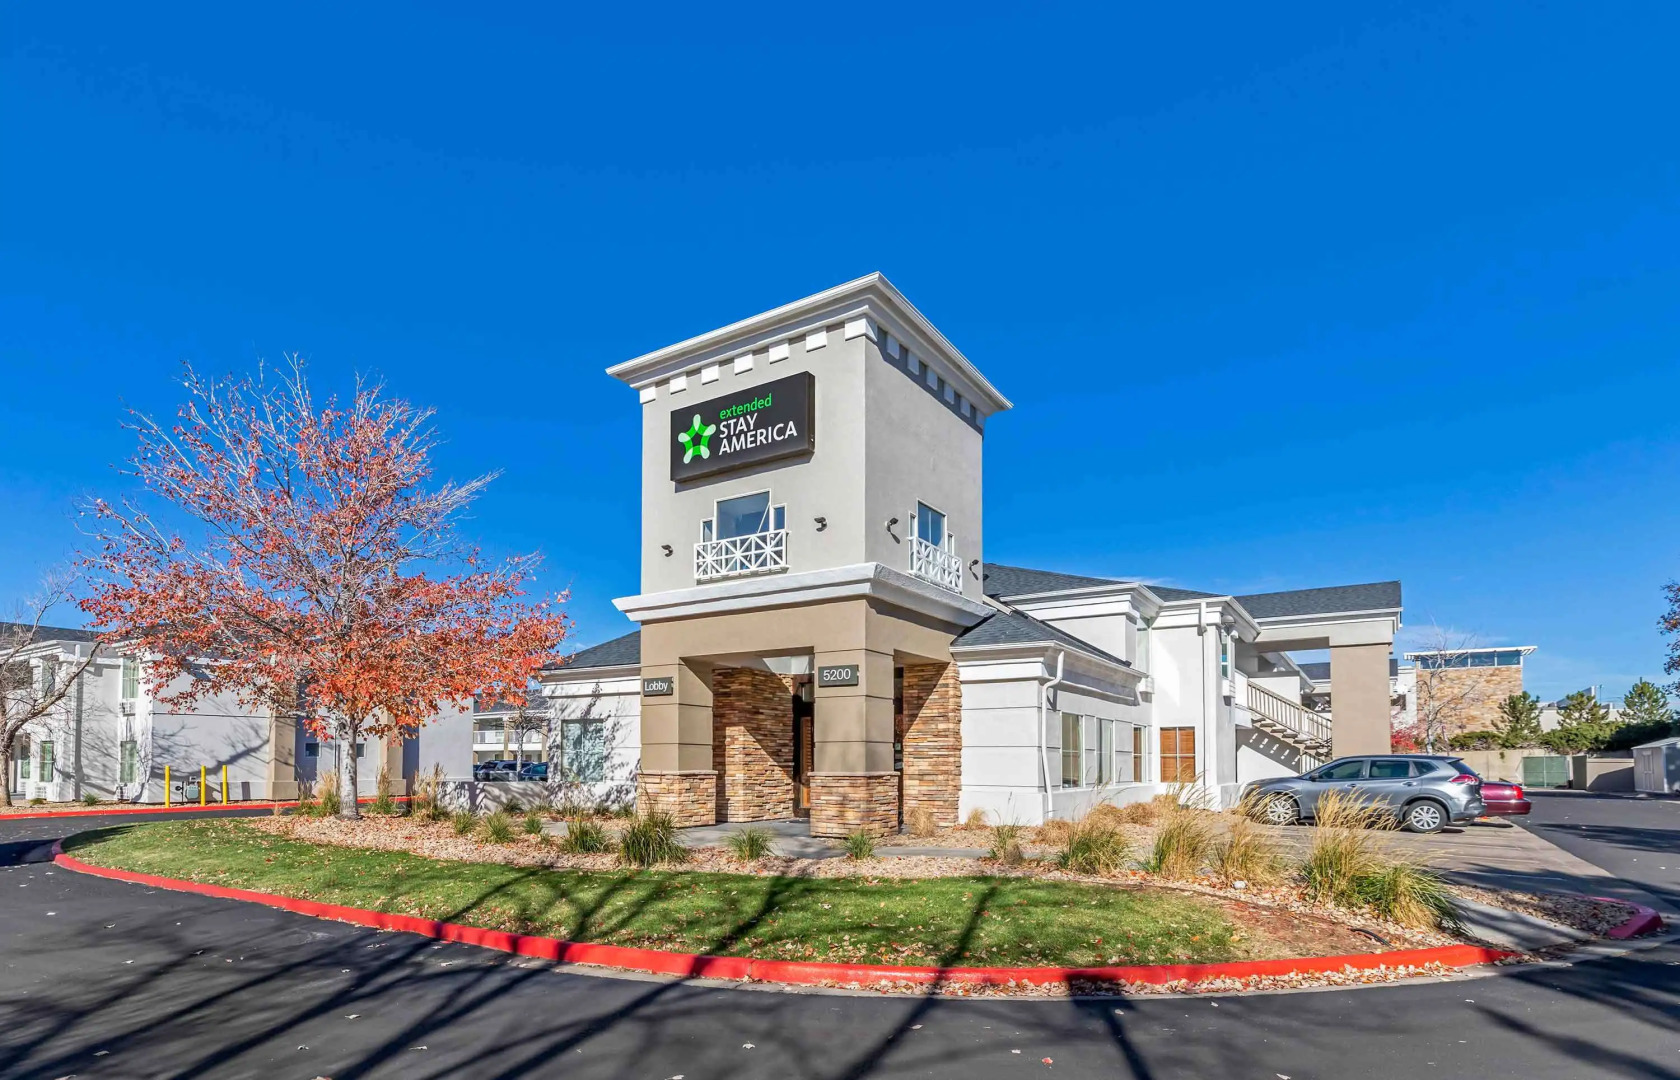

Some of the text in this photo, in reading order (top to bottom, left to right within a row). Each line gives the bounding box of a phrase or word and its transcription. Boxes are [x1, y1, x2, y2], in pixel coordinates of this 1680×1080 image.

[719, 393, 772, 420] extended
[718, 420, 798, 456] AMERICA
[719, 412, 758, 438] STAY
[644, 680, 668, 693] Lobby
[823, 668, 851, 681] 5200
